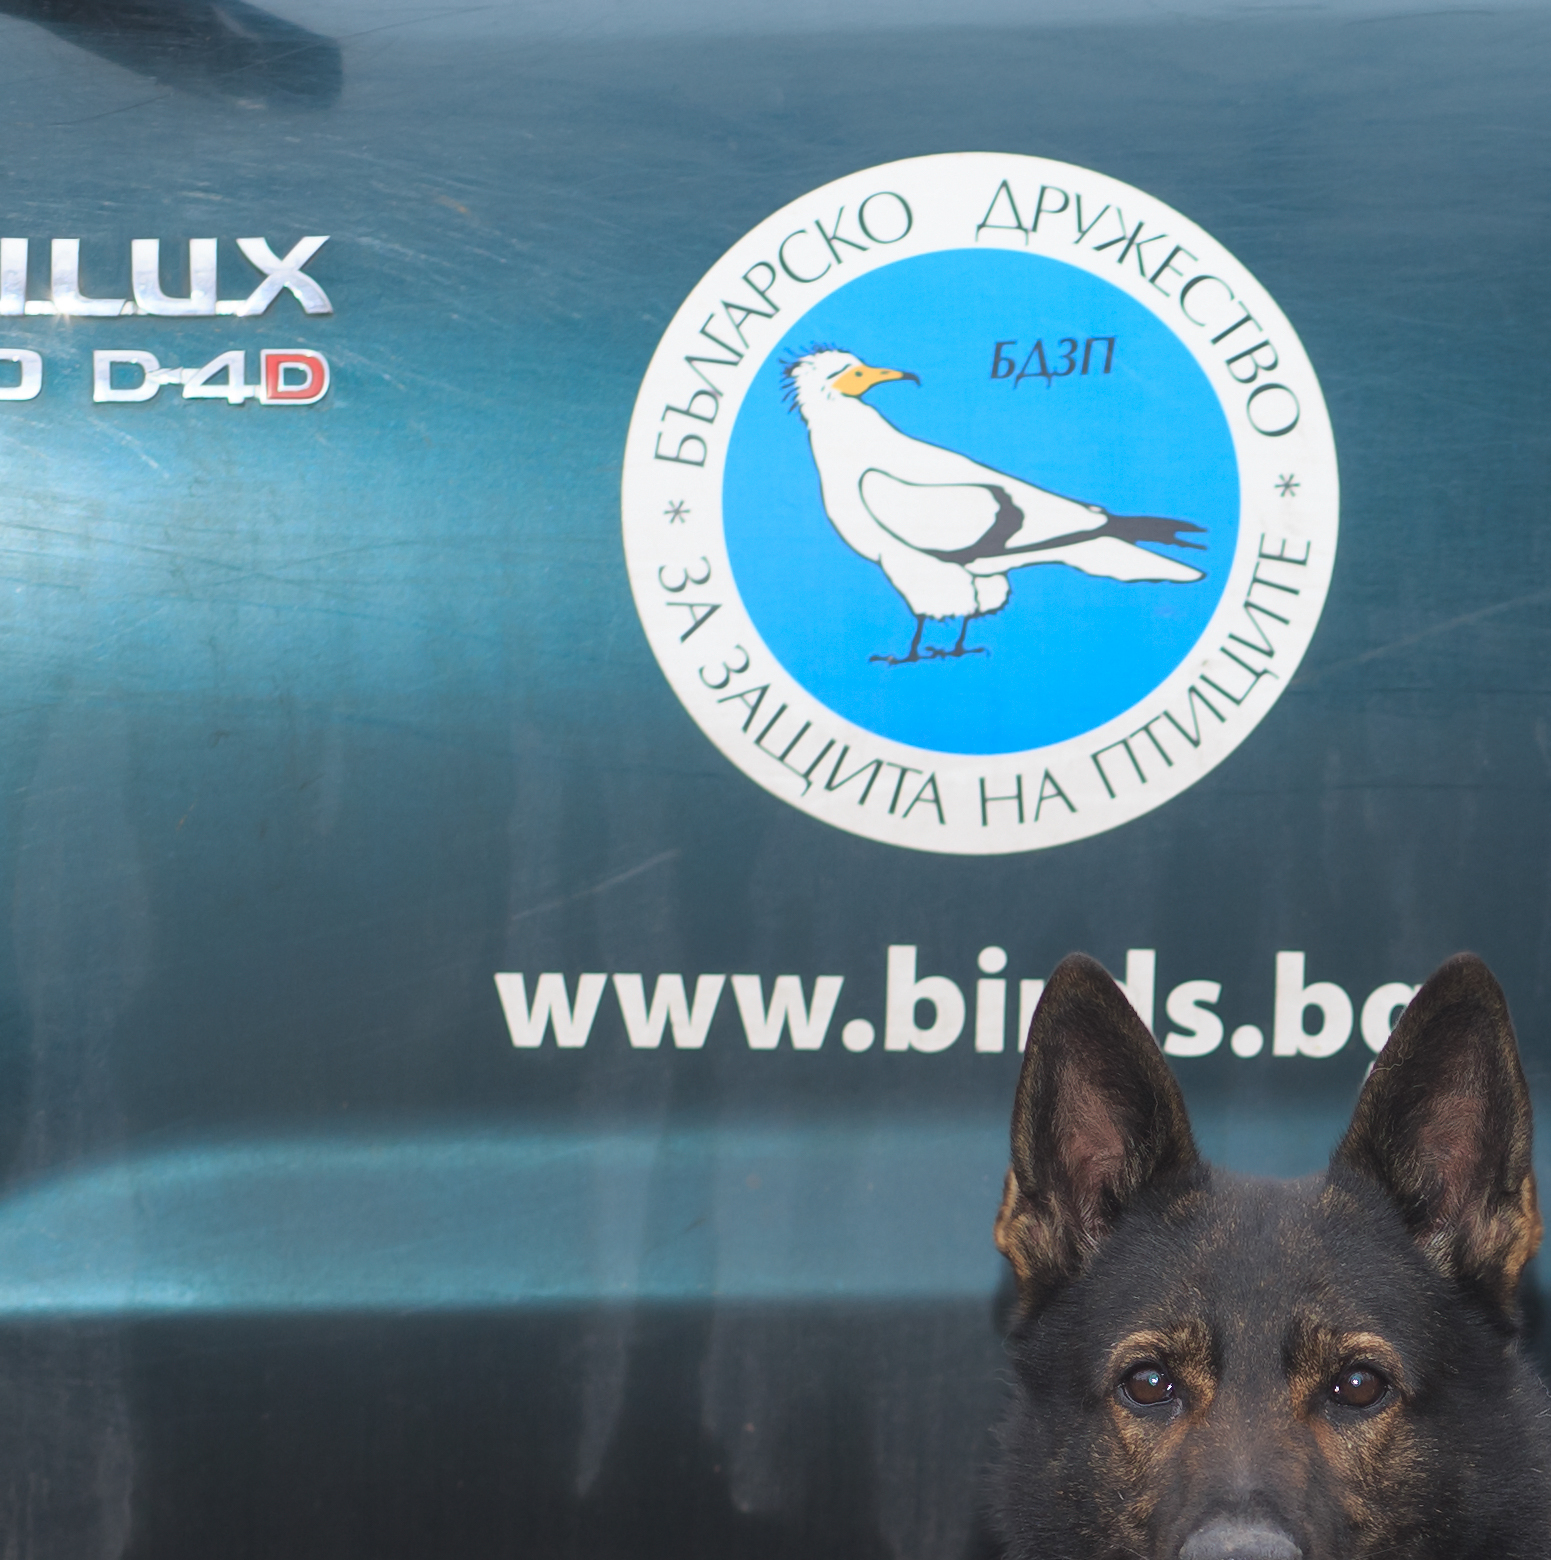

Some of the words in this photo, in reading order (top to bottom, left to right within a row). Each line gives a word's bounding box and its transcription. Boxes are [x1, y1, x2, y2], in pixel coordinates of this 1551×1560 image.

[93, 349, 330, 405] D-4D
[653, 190, 914, 468] БЪЛГАРСКО
[974, 179, 1301, 438] ДРУЖЕСТВО
[990, 335, 1116, 389] БДЗП
[657, 556, 722, 644] ЗА
[697, 644, 947, 826] ЗАЩИТА
[978, 767, 1079, 827] НА
[1089, 532, 1312, 800] ПТИЦИТЕ
